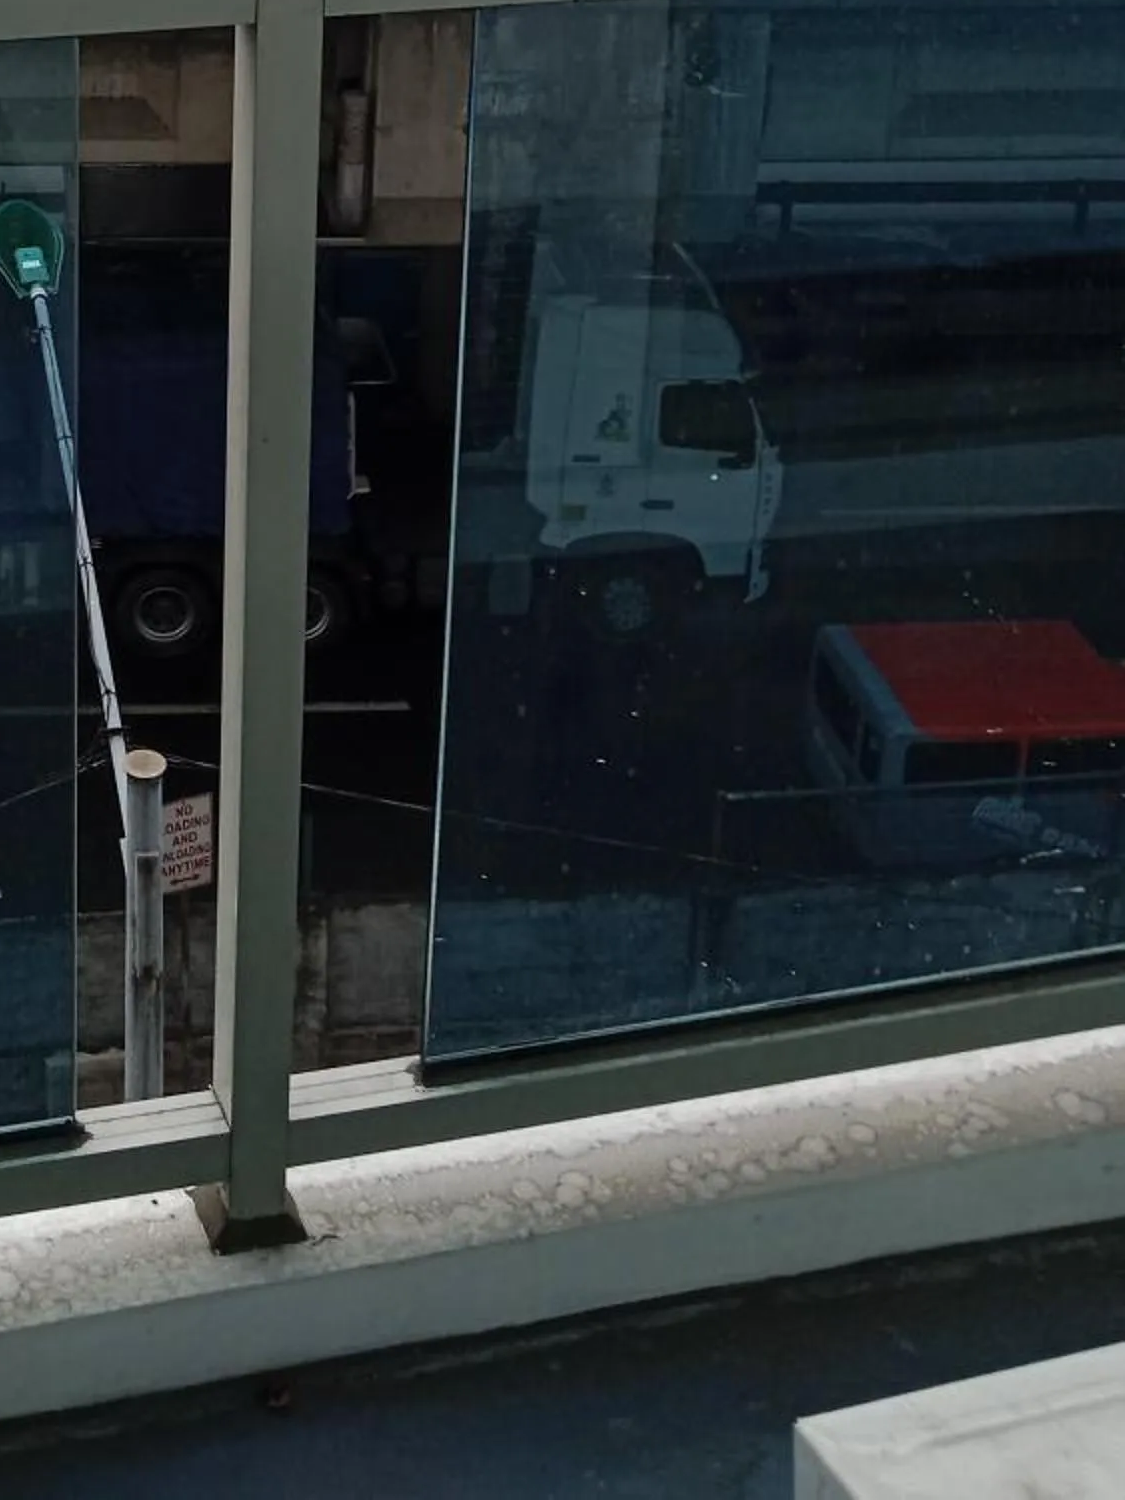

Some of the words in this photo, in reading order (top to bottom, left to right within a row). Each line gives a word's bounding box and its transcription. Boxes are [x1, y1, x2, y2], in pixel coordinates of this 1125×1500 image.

[175, 804, 194, 818] NO
[163, 814, 211, 836] OADING
[172, 831, 198, 847] AND
[162, 841, 211, 864] NLOADING
